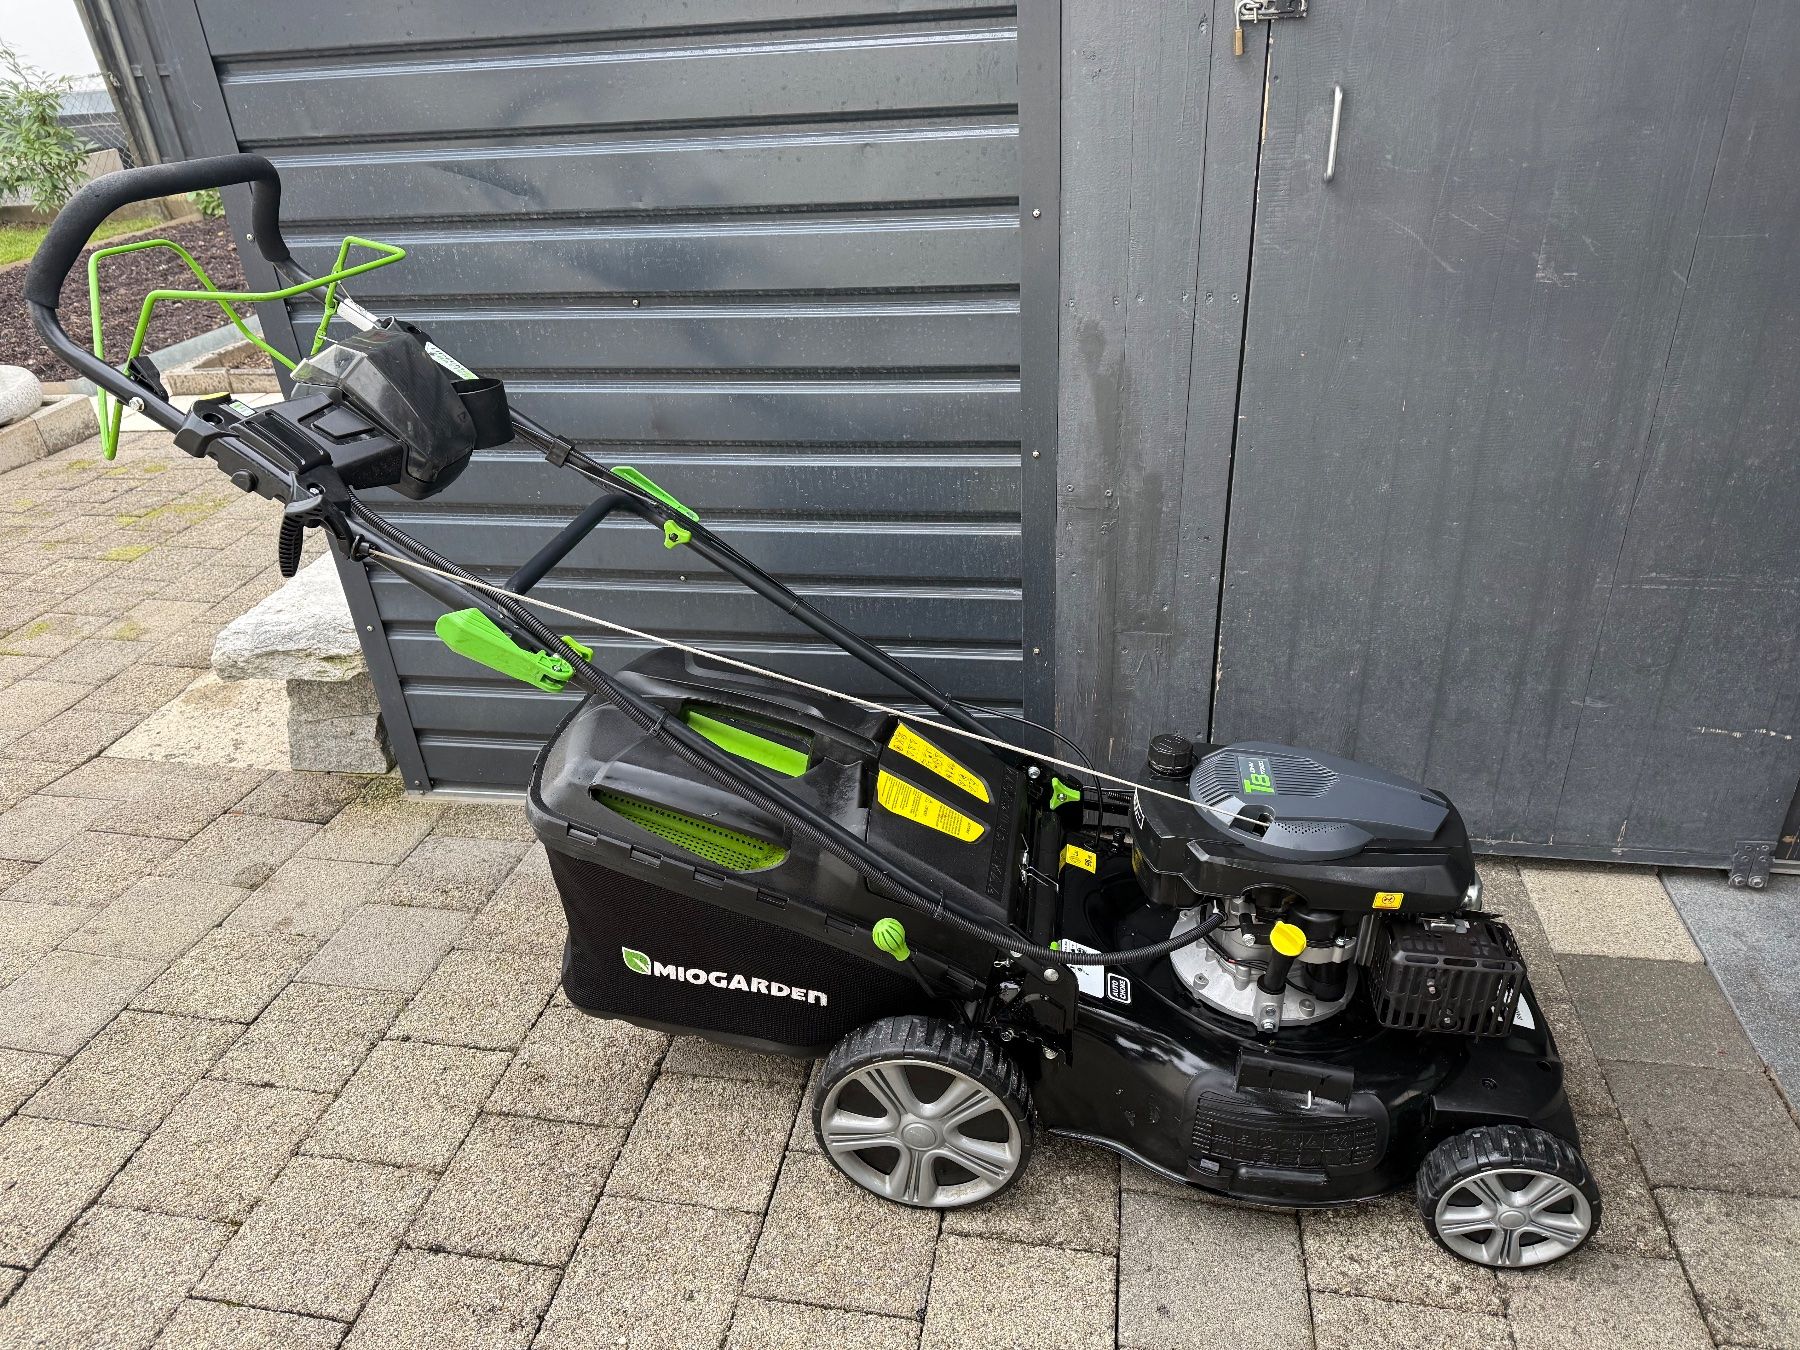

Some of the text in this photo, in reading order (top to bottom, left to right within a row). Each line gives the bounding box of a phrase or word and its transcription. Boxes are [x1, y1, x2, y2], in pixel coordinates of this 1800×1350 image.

[653, 960, 828, 1007] MIOGARDEN
[1111, 979, 1119, 997] AUTO
[1119, 979, 1127, 999] CHOKE
